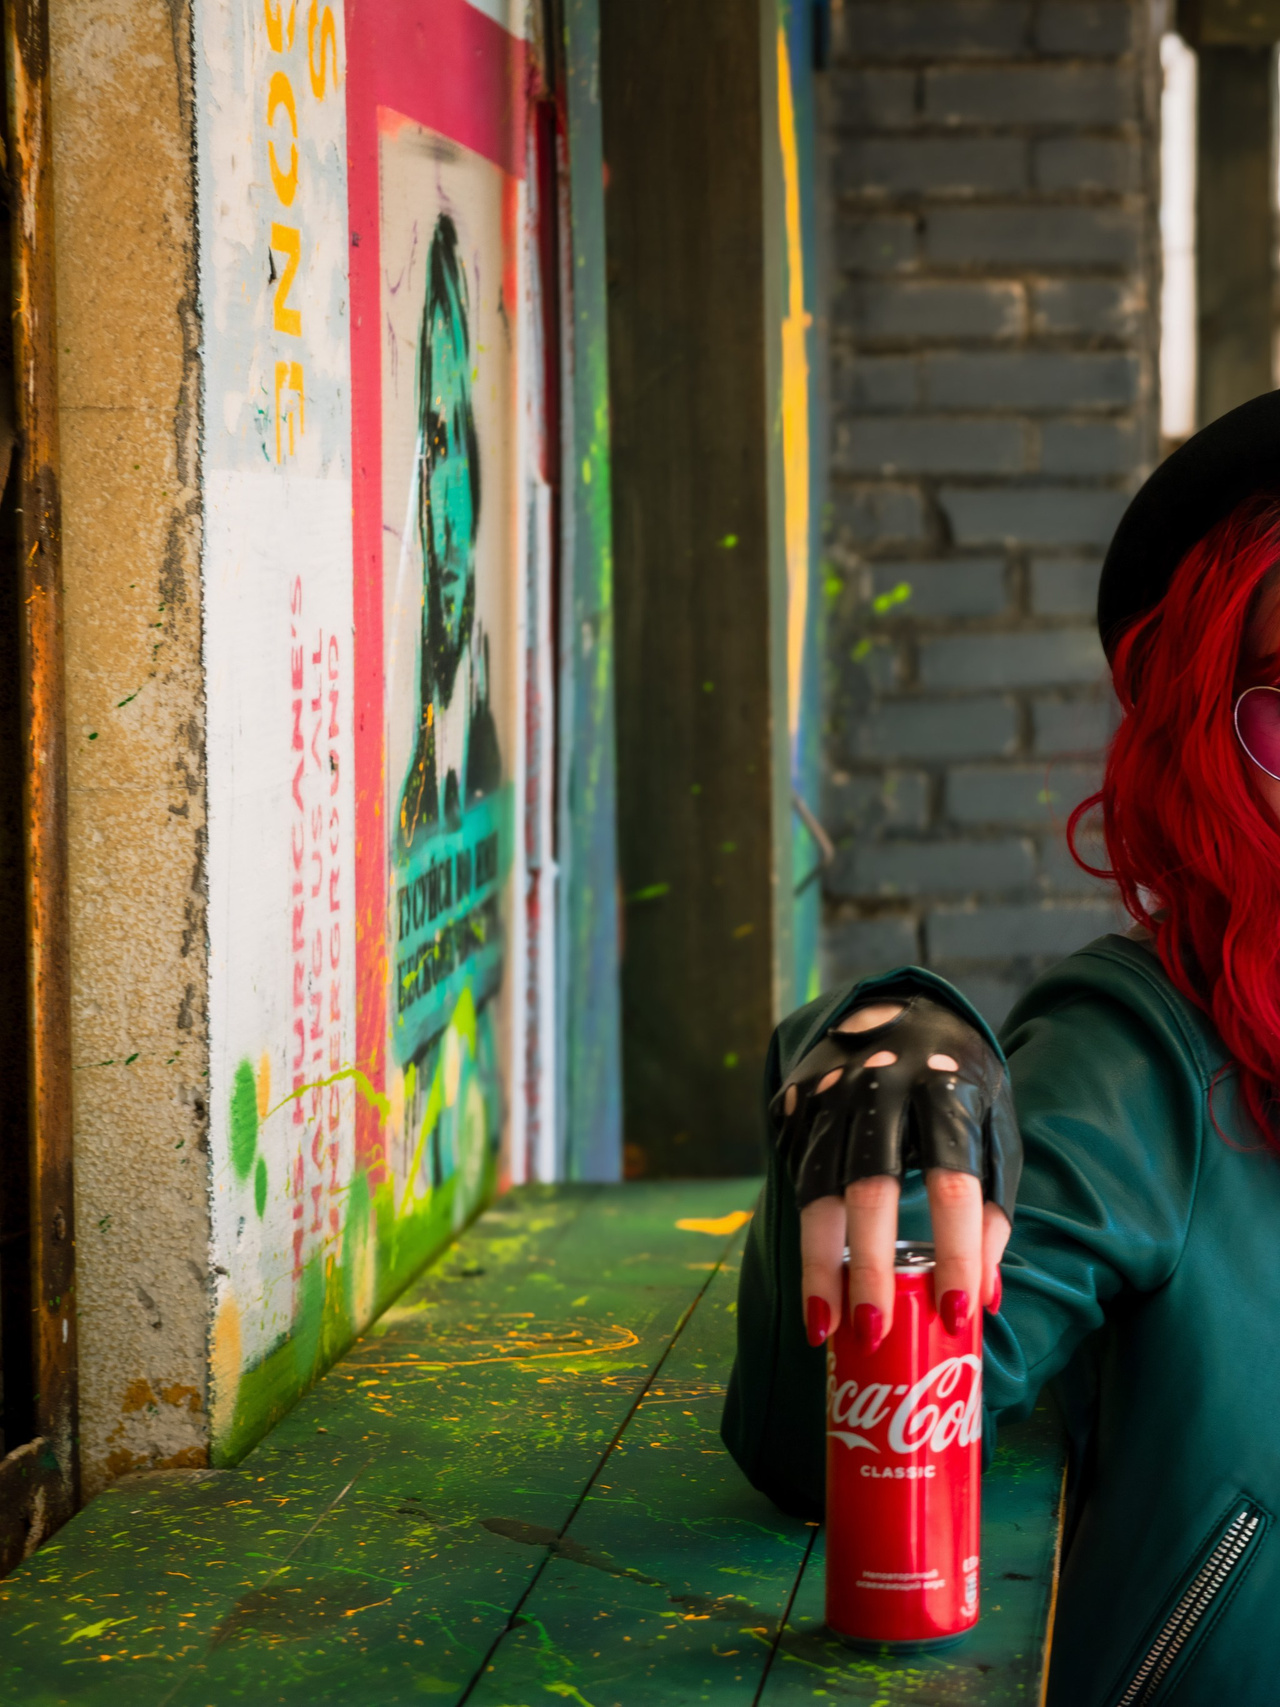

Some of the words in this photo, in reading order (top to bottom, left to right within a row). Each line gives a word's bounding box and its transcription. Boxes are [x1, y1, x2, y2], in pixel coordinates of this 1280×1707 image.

[310, 627, 324, 771] ALL
[290, 573, 305, 1125] HURRICANE'S
[310, 804, 324, 898] US
[310, 929, 324, 1252] HASING
[827, 1351, 982, 1454] oca-Col
[860, 1465, 936, 1479] CLASSIC
